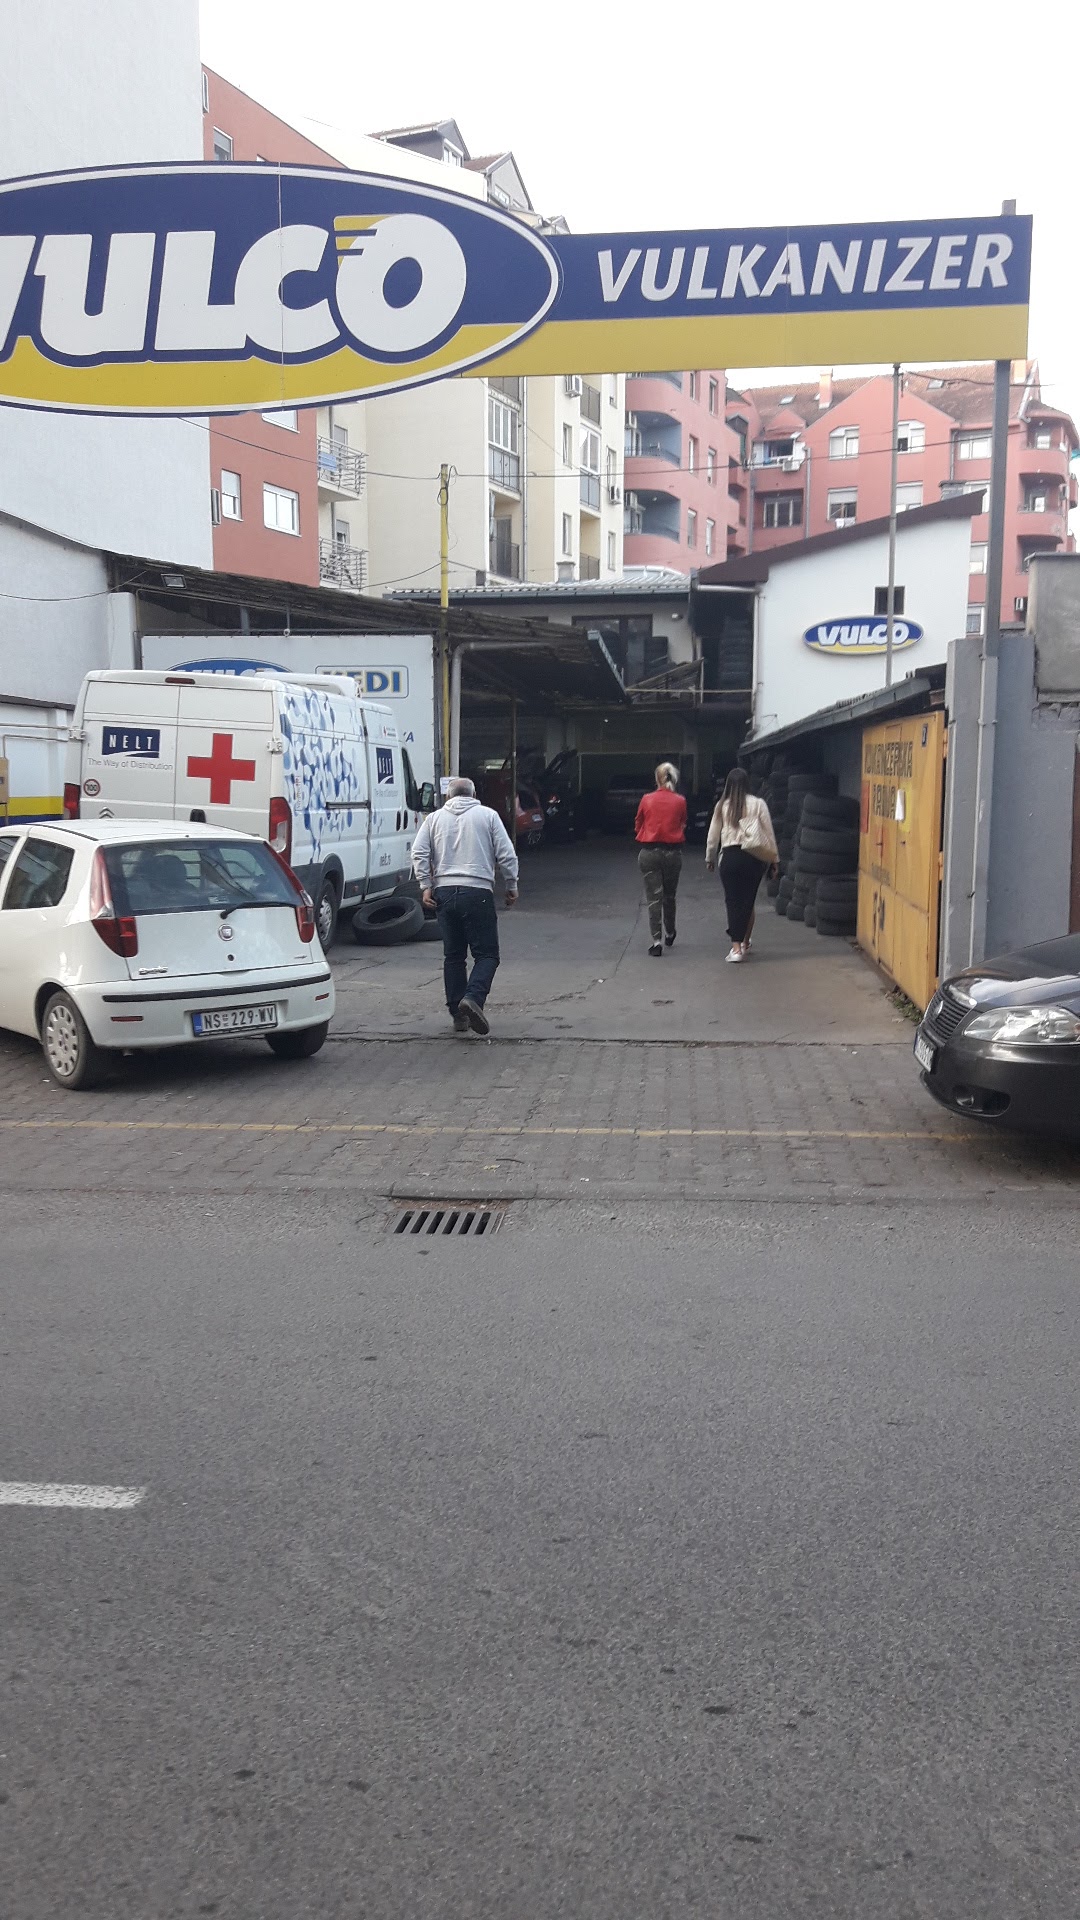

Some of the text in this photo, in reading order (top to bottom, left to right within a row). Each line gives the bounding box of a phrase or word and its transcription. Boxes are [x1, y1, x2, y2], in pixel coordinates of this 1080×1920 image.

[597, 232, 1014, 302] VULKANIZER
[0, 213, 467, 356] ULCO
[817, 622, 910, 646] VULCO
[108, 734, 153, 750] NELT
[88, 757, 174, 771] The Way of Distribution
[204, 1013, 221, 1029] NS
